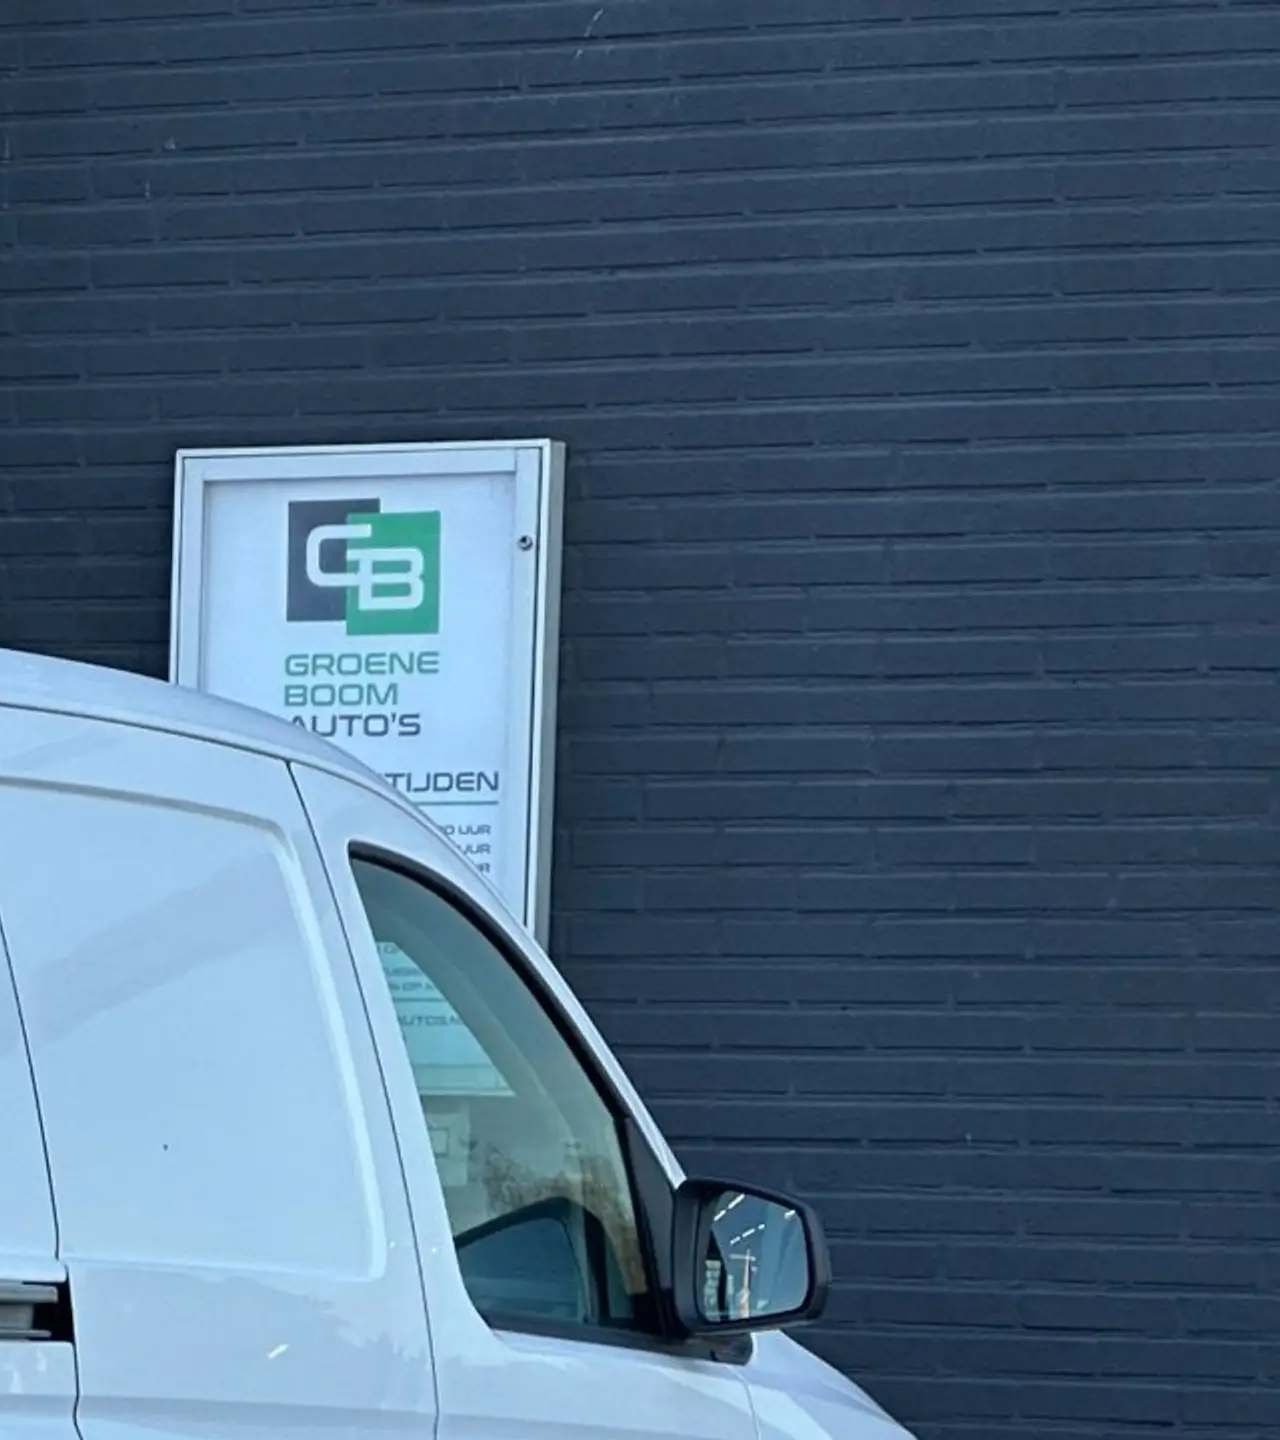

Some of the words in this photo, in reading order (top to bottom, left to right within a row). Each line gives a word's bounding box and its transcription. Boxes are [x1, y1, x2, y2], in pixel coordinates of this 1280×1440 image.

[284, 651, 440, 676] GROENE
[283, 683, 399, 707] BOOM
[378, 771, 500, 792] TIJDEN
[458, 825, 492, 835] UUR
